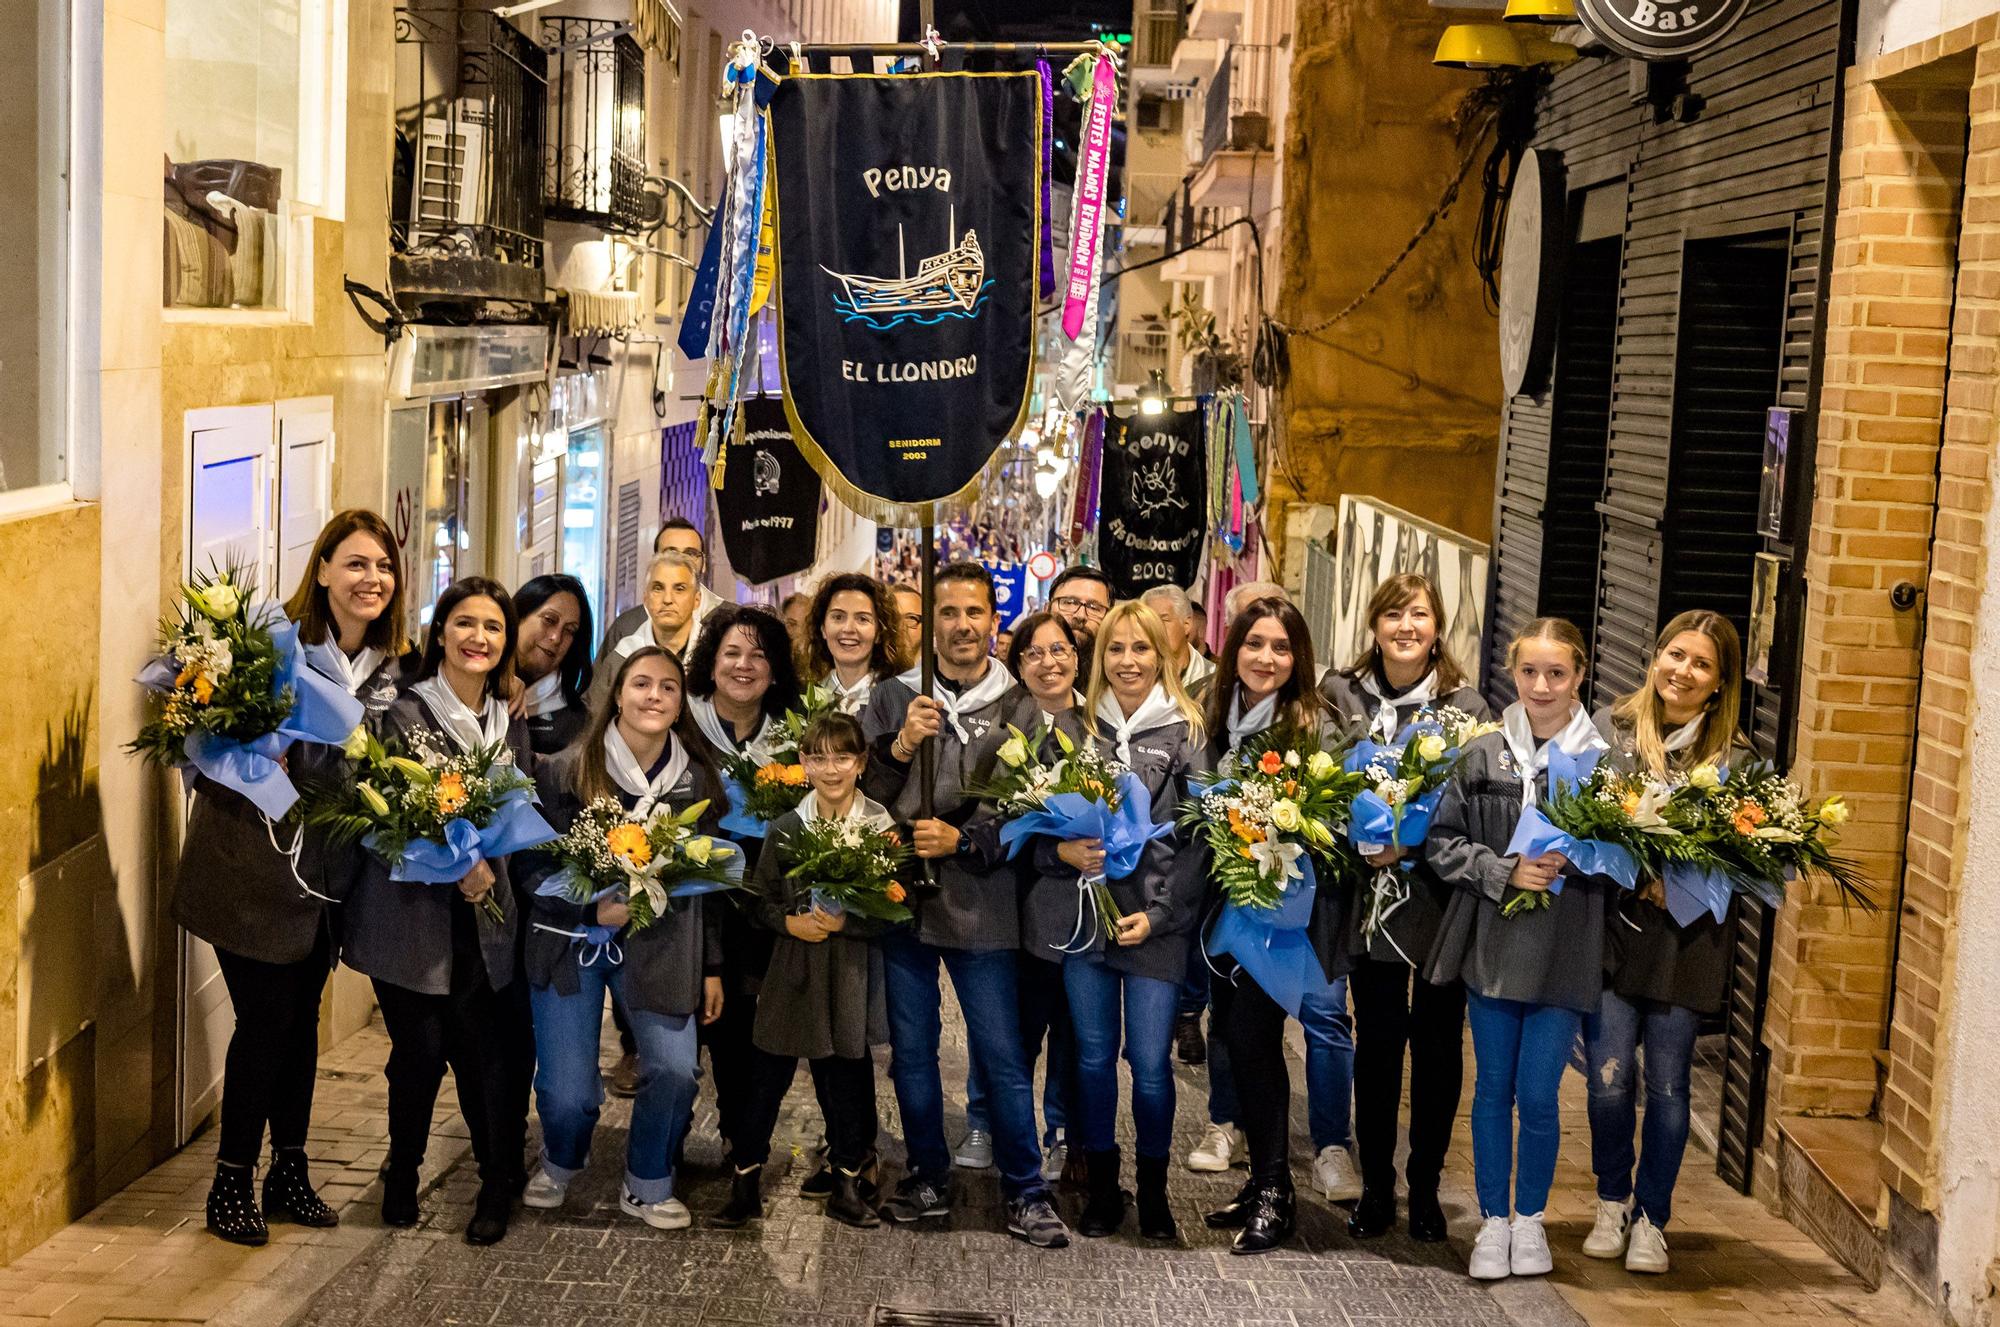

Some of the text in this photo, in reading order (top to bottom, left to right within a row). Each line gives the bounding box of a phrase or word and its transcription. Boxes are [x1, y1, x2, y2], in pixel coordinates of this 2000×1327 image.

[1630, 0, 1698, 30] Bar
[1091, 102, 1107, 147] FESTES
[863, 165, 951, 198] Penya
[1084, 149, 1101, 200] MAJORS
[1073, 267, 1088, 276] 2022
[842, 354, 977, 382] EL LLONDRO
[903, 452, 927, 460] 2003
[1128, 432, 1190, 458] Penya
[770, 516, 794, 529] 1997
